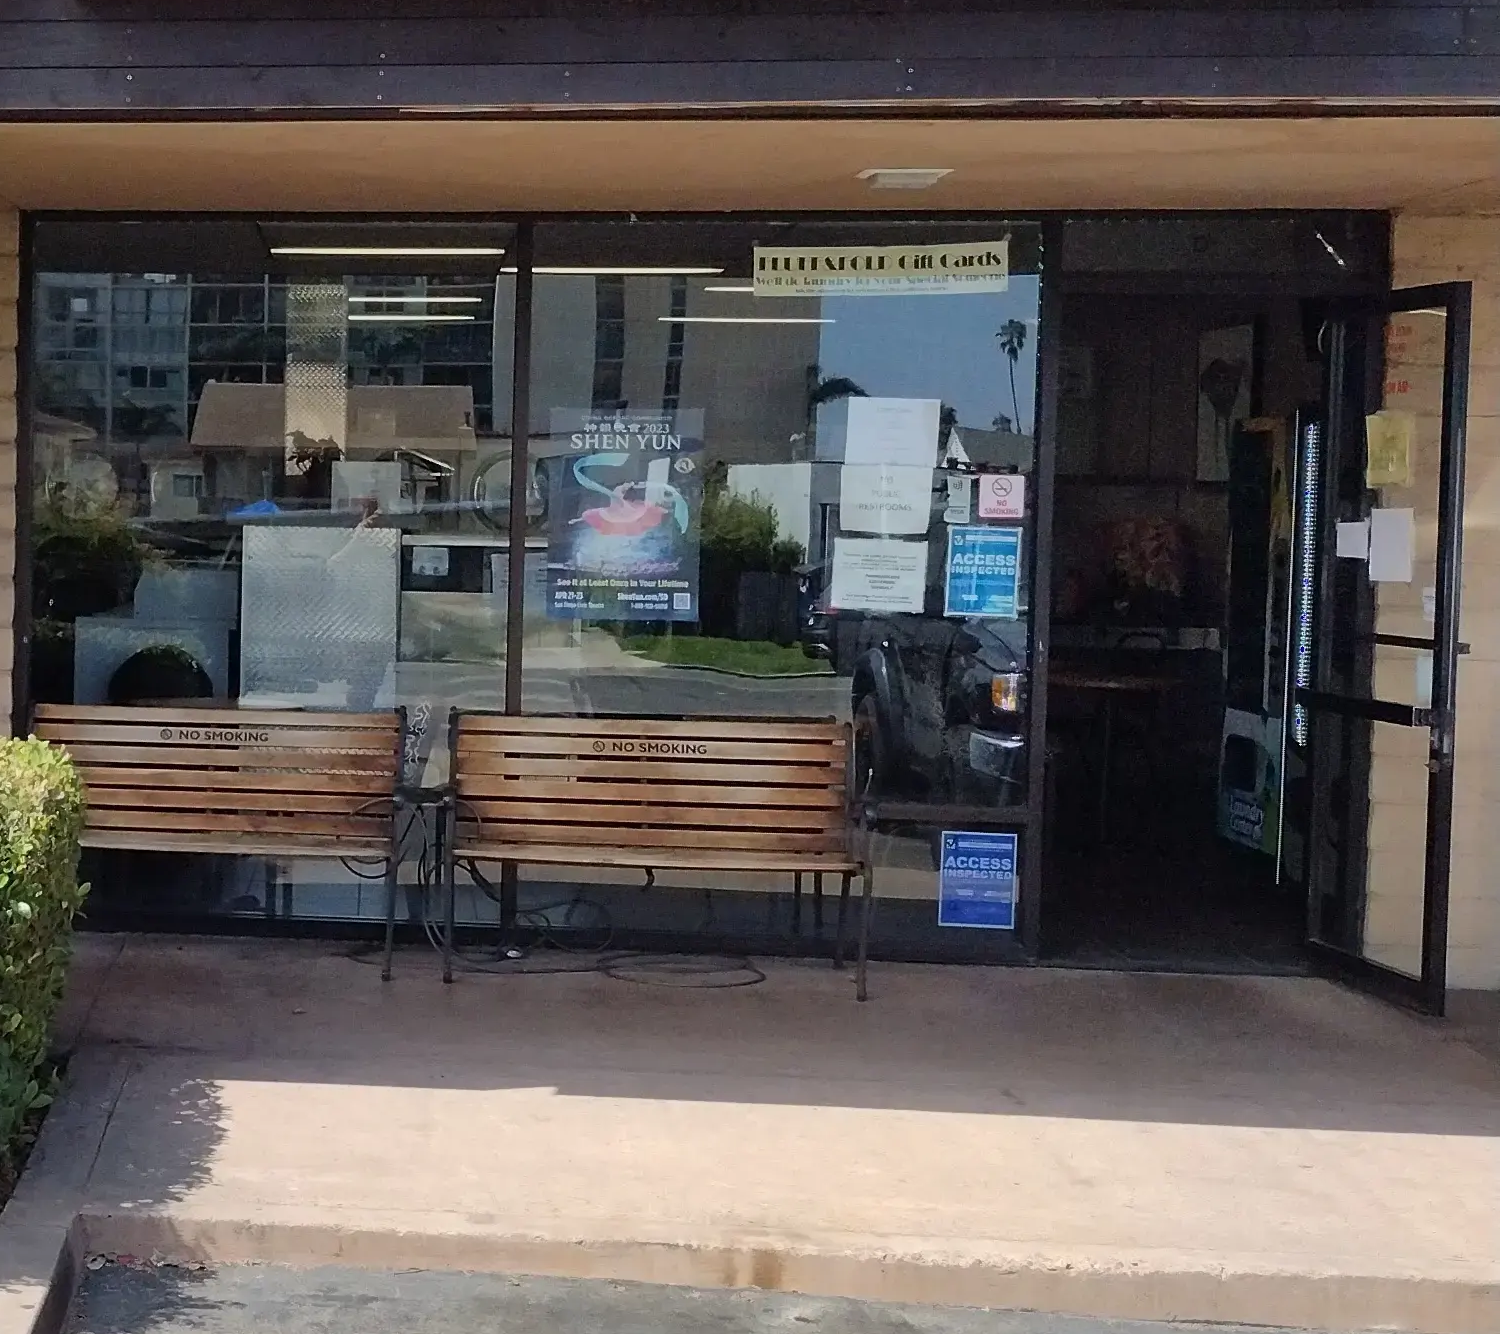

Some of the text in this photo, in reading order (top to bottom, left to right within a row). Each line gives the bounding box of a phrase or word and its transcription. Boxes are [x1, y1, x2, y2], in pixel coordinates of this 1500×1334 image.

[898, 254, 934, 270] Gift
[939, 251, 1003, 269] Cards
[643, 423, 670, 434] 2023
[570, 434, 681, 450] SHEN YUN
[996, 499, 1008, 507] NO
[983, 507, 1019, 516] SMOKING
[953, 553, 1016, 566] ACCESS
[951, 565, 1015, 576] INSPECTED
[178, 730, 269, 742] NO SMOKING
[612, 742, 708, 755] NO SMOKING
[944, 856, 1012, 870] ACCESS
[943, 868, 1013, 880] INSPECTED
